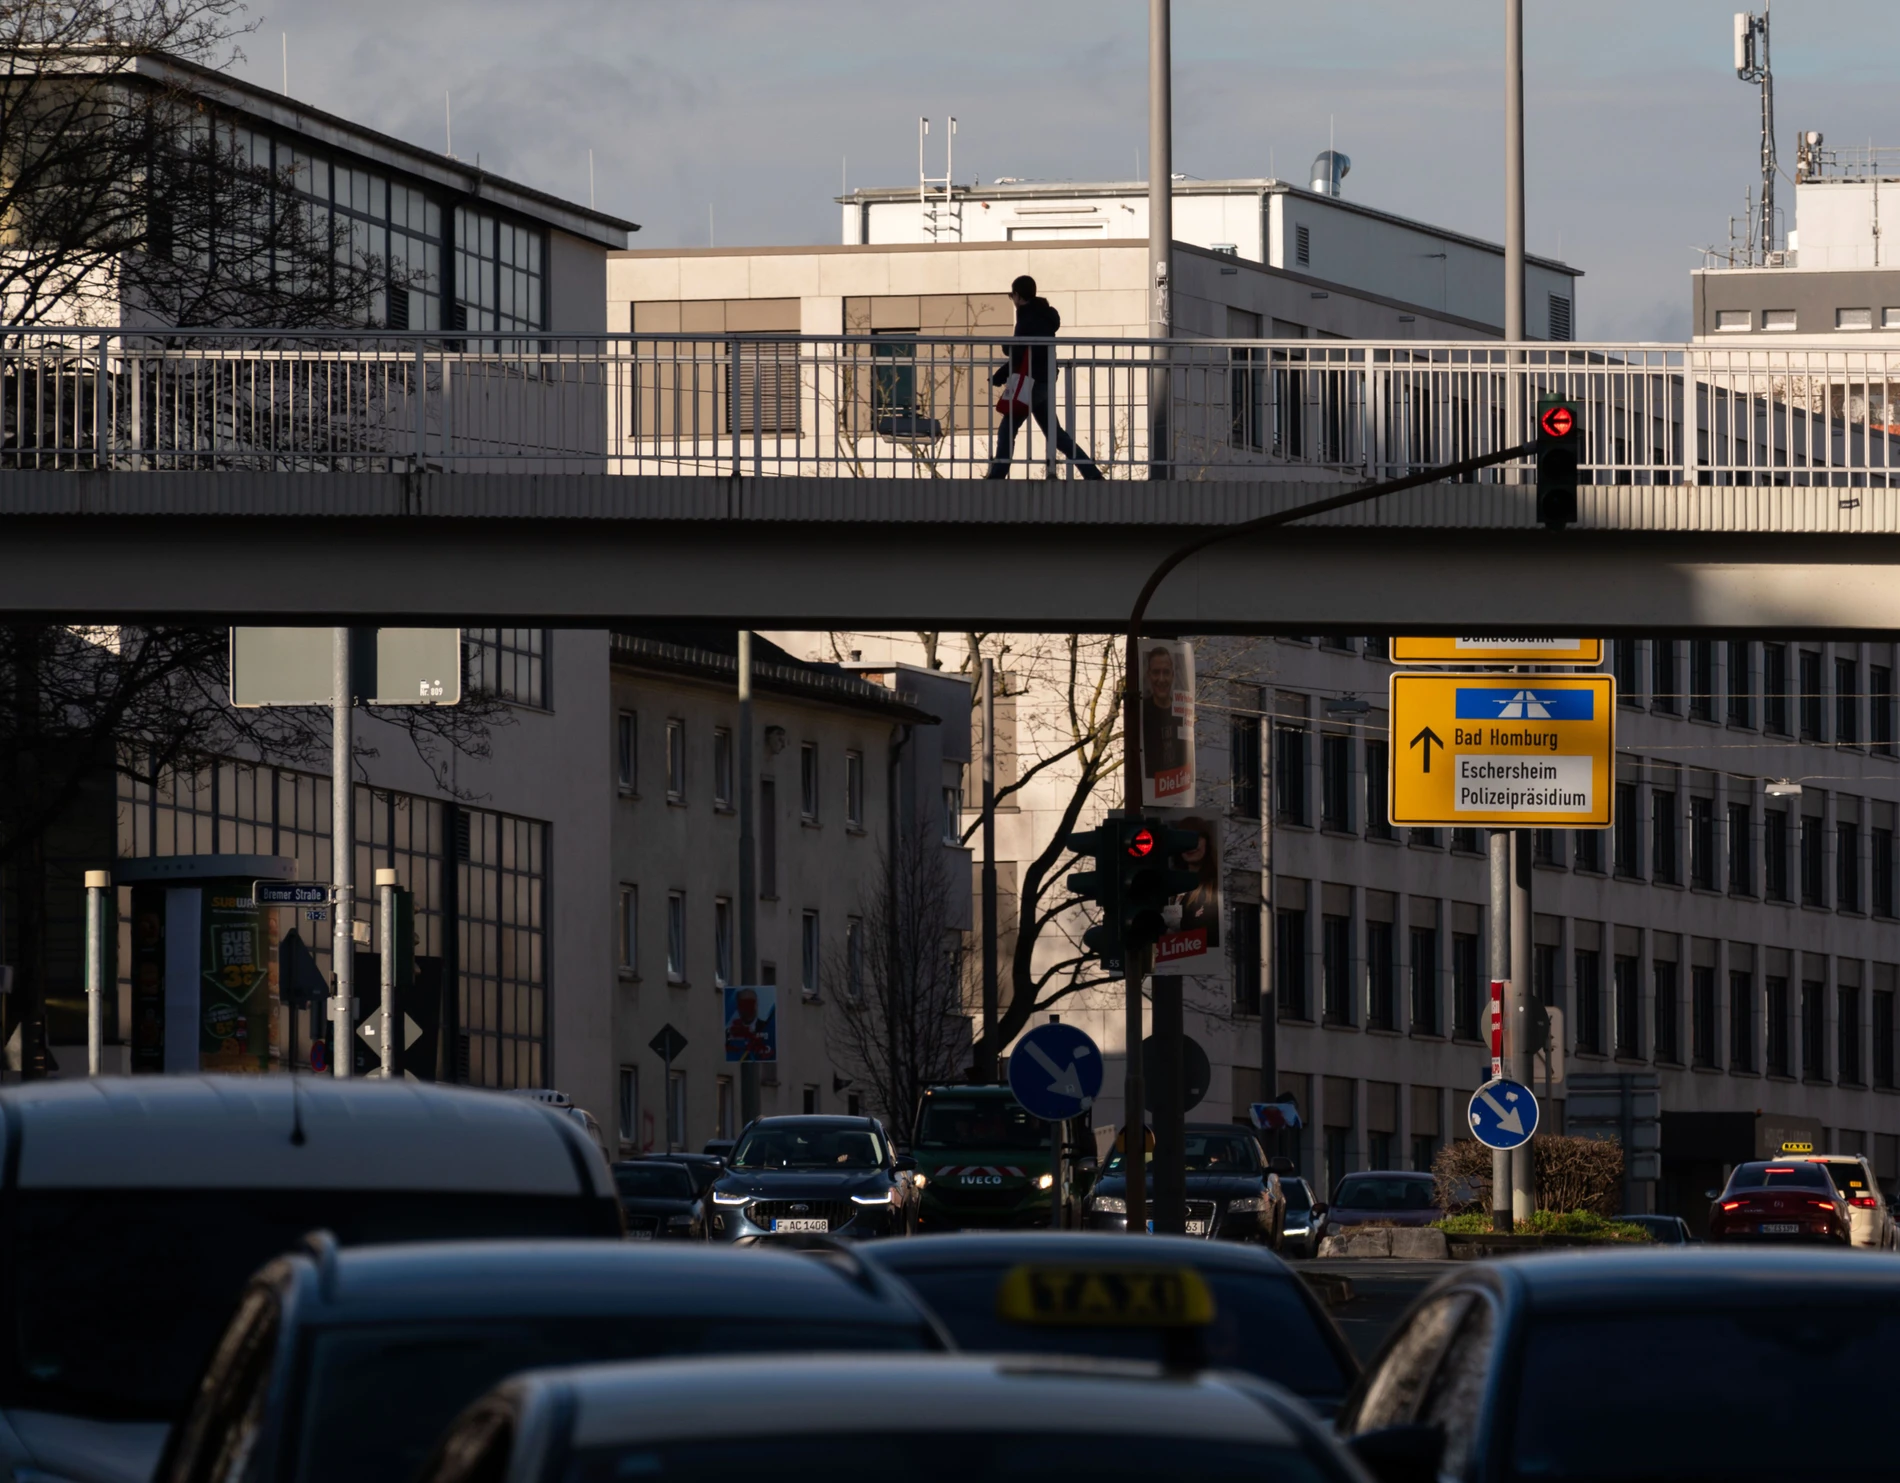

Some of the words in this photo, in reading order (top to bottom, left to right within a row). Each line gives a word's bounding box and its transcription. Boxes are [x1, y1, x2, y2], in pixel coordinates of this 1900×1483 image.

[430, 687, 443, 696] 809
[1455, 728, 1482, 745] Bad
[1490, 728, 1558, 750] Homburg
[1461, 761, 1557, 779] Eschersheim
[1159, 777, 1175, 792] Die
[1461, 787, 1586, 809] Polizeipräsidium
[263, 888, 292, 900] Bremer
[295, 889, 321, 900] Straße
[221, 931, 252, 944] SUB
[221, 944, 252, 957] DES
[1161, 936, 1202, 956] Linke
[961, 1176, 1002, 1185] IVECO
[790, 1221, 801, 1230] AC
[804, 1221, 827, 1230] 1408
[1033, 1270, 1180, 1313] TAXI
